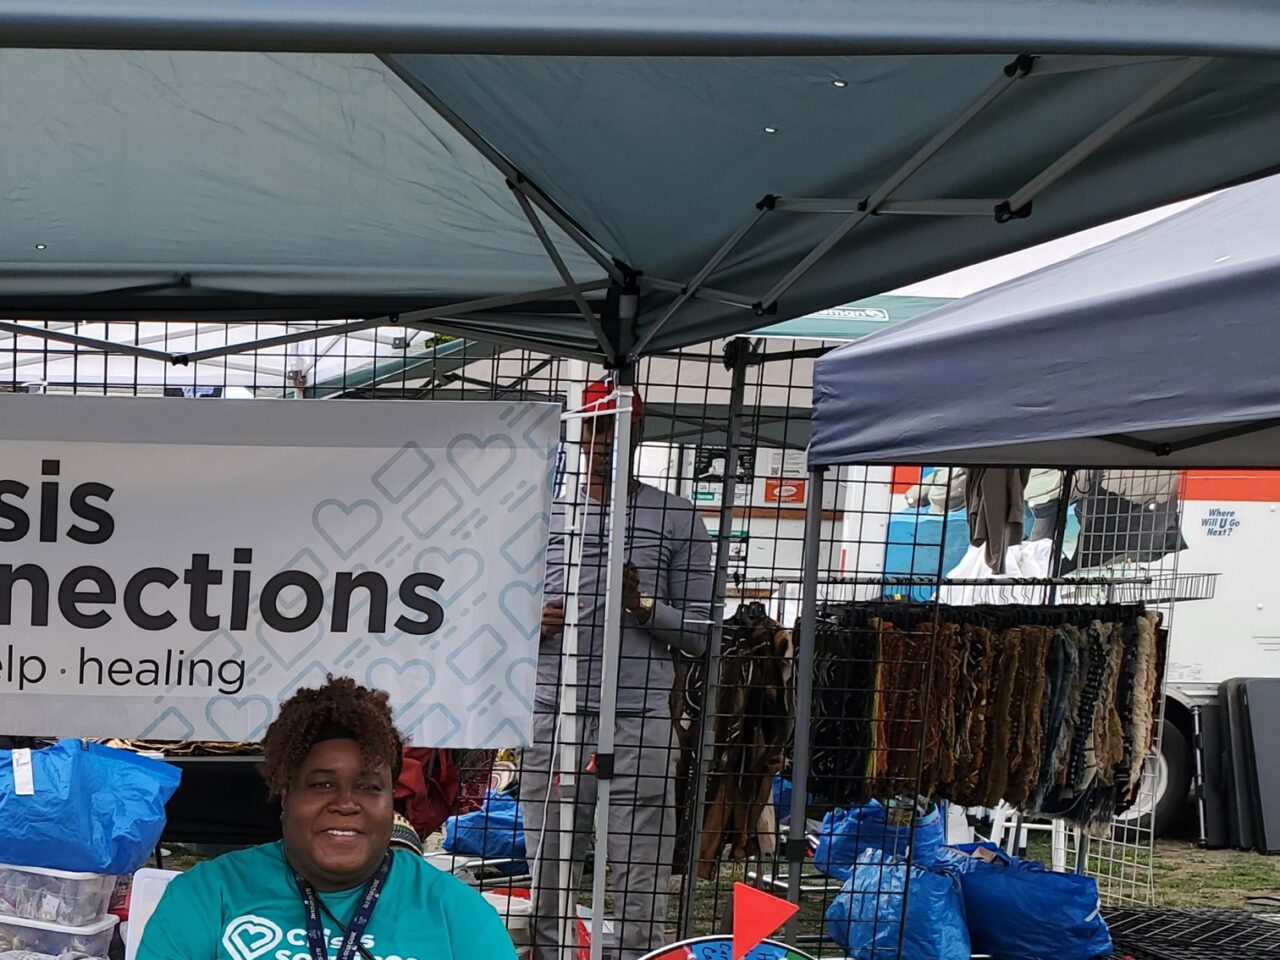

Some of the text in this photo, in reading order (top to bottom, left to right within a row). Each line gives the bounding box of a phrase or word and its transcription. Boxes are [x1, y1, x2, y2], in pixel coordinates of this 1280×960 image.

[1209, 508, 1235, 517] Where
[1201, 518, 1240, 528] Will U Go
[1207, 528, 1233, 536] Next?
[78, 647, 246, 694] healing
[286, 928, 375, 949] ciss
